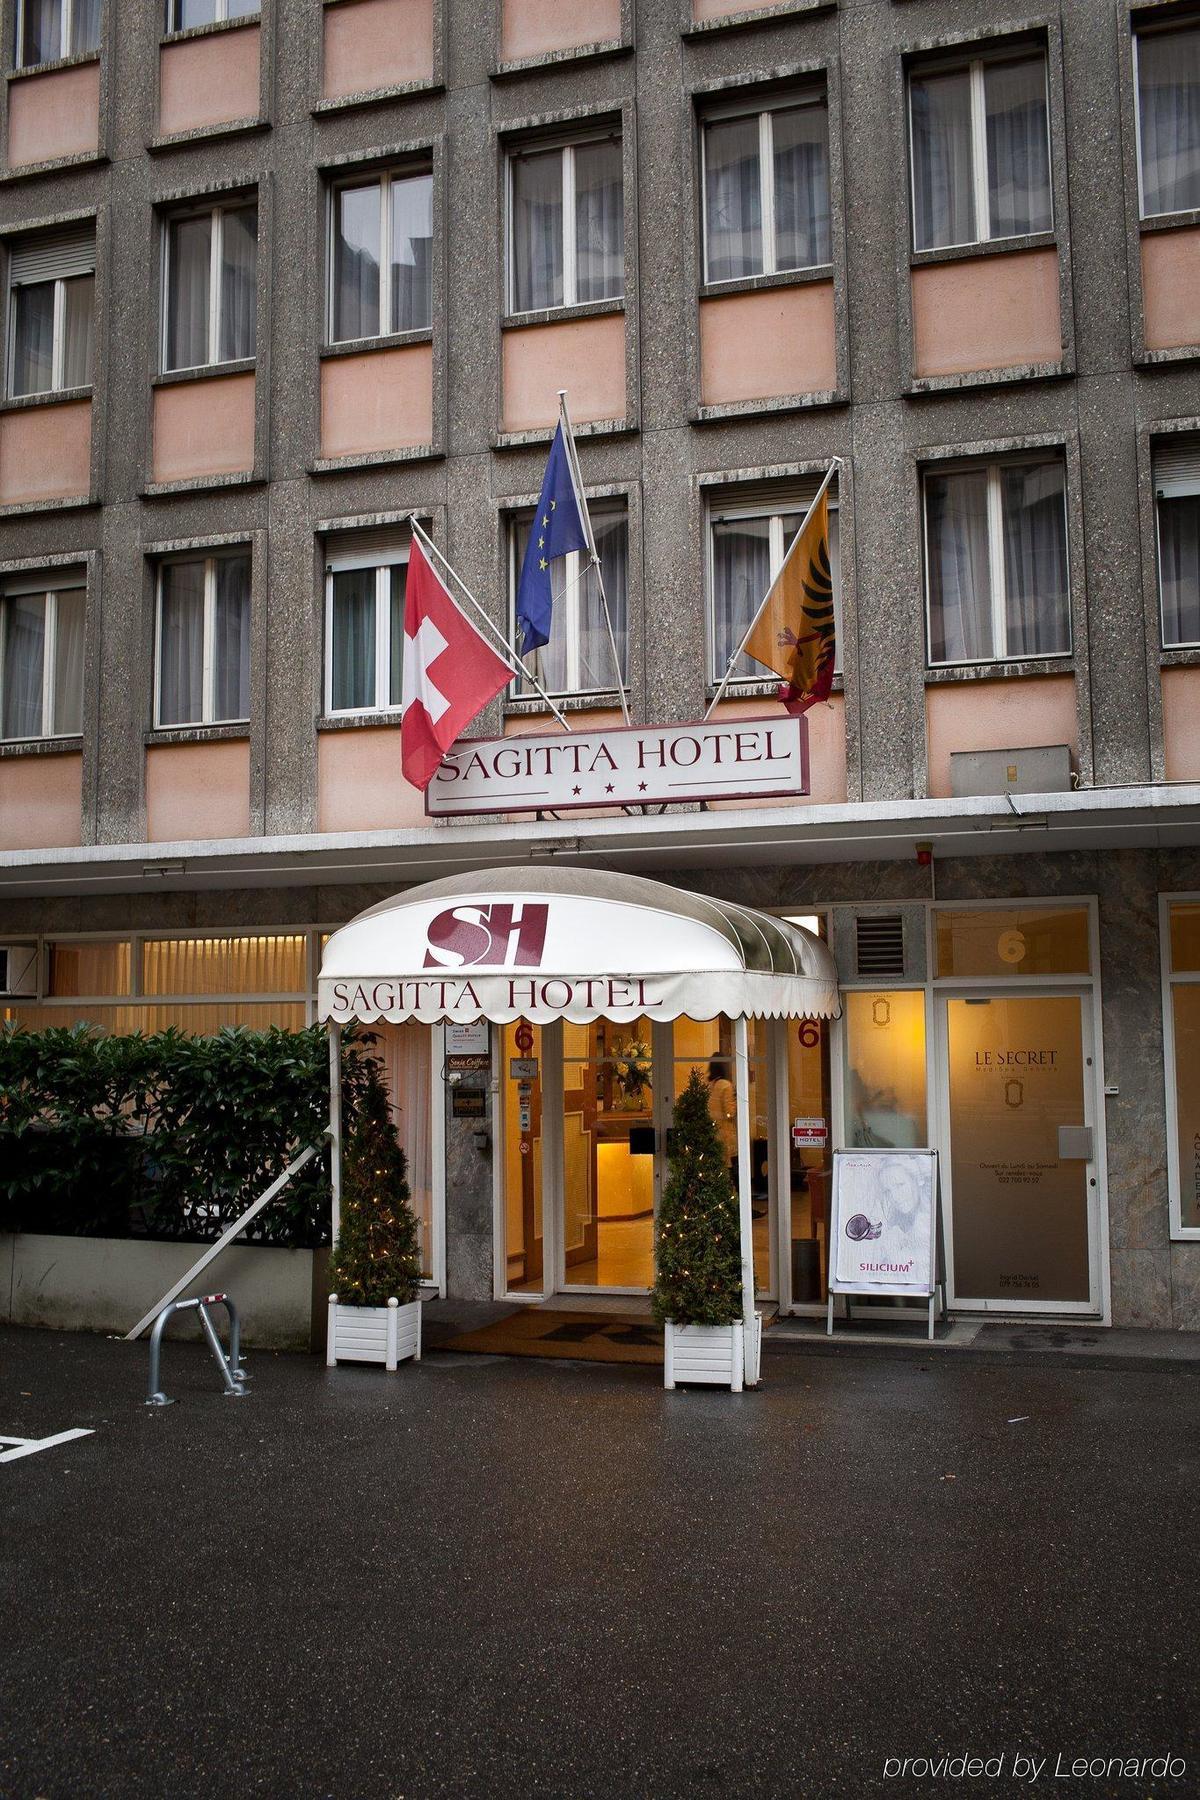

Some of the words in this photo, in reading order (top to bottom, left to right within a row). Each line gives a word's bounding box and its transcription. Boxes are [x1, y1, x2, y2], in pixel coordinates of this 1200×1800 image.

[436, 741, 619, 782] SAGITTA
[637, 730, 792, 769] HOTEL
[422, 903, 550, 968] SH
[997, 929, 1027, 964] 6
[332, 981, 483, 1012] SAGITTA
[507, 979, 664, 1009] HOTEL
[514, 1023, 534, 1051] 6
[797, 1019, 820, 1048] 6
[975, 1051, 992, 1065] LE
[997, 1050, 1058, 1065] SECRET
